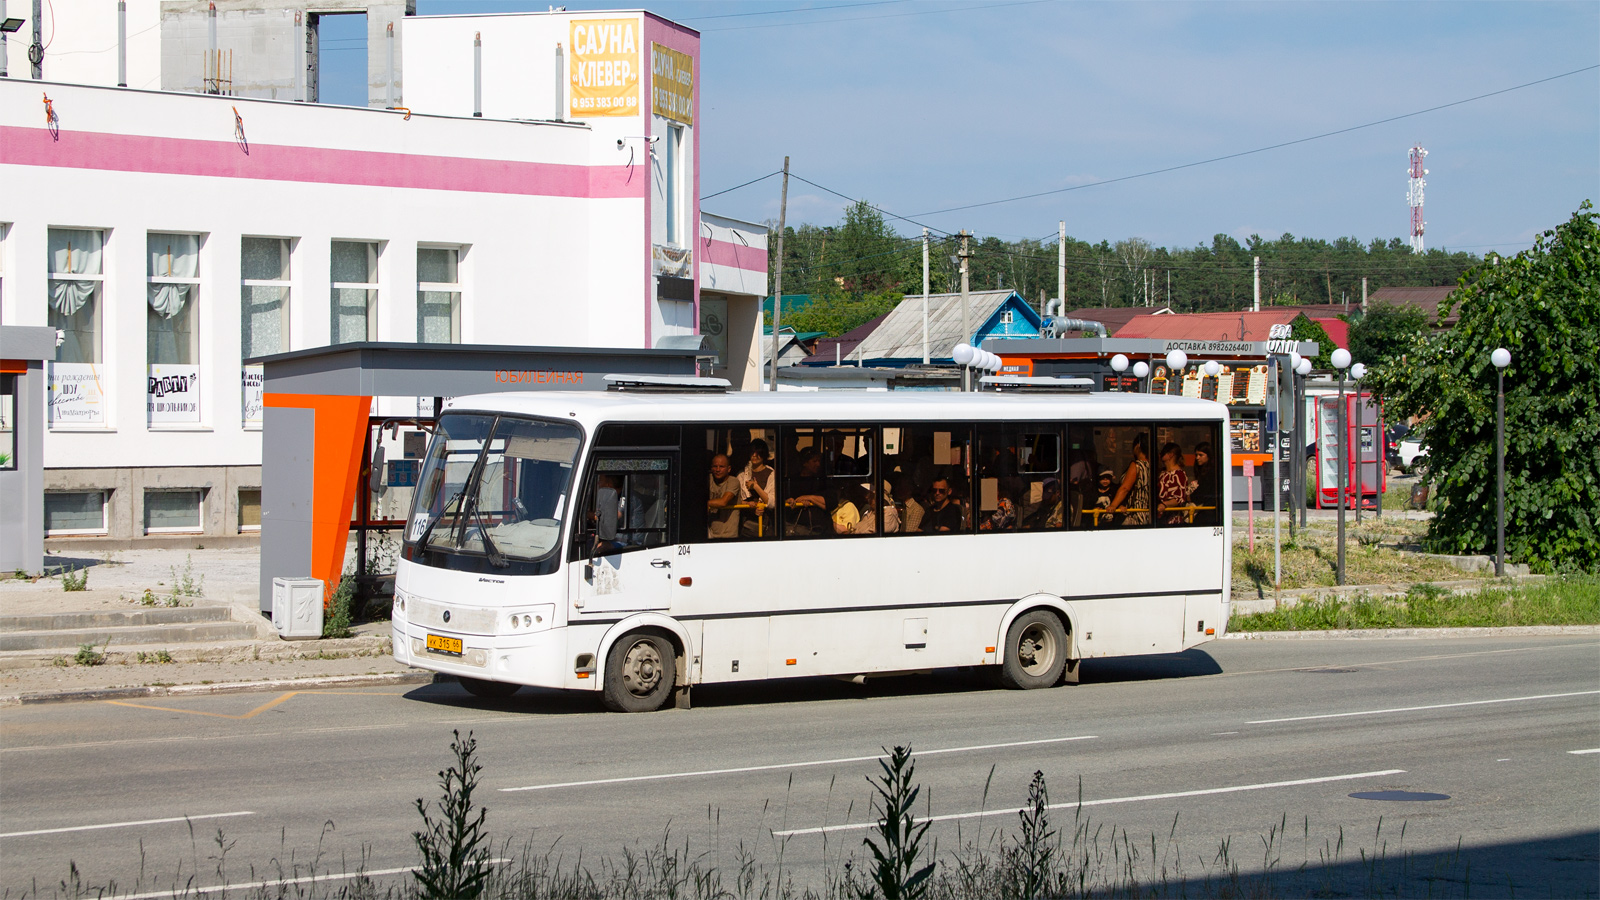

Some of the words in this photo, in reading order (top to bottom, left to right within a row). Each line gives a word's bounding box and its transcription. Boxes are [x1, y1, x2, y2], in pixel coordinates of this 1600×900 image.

[574, 24, 635, 55] САУНА
[652, 50, 674, 81] САУНА
[572, 98, 578, 108] 8
[580, 97, 594, 108] 953
[596, 97, 611, 108] 383
[613, 97, 625, 107] 00
[626, 96, 637, 107] 88
[1166, 341, 1207, 352] ДОСТАВКА
[1208, 342, 1252, 352] 89826264401
[495, 368, 584, 385] ЮБИЛЕЙНАЯ
[148, 375, 188, 397] PARTY
[413, 518, 427, 535] 116
[1213, 527, 1223, 536] 204
[678, 545, 691, 556] 204
[439, 638, 450, 649] 315
[453, 640, 460, 648] 66
